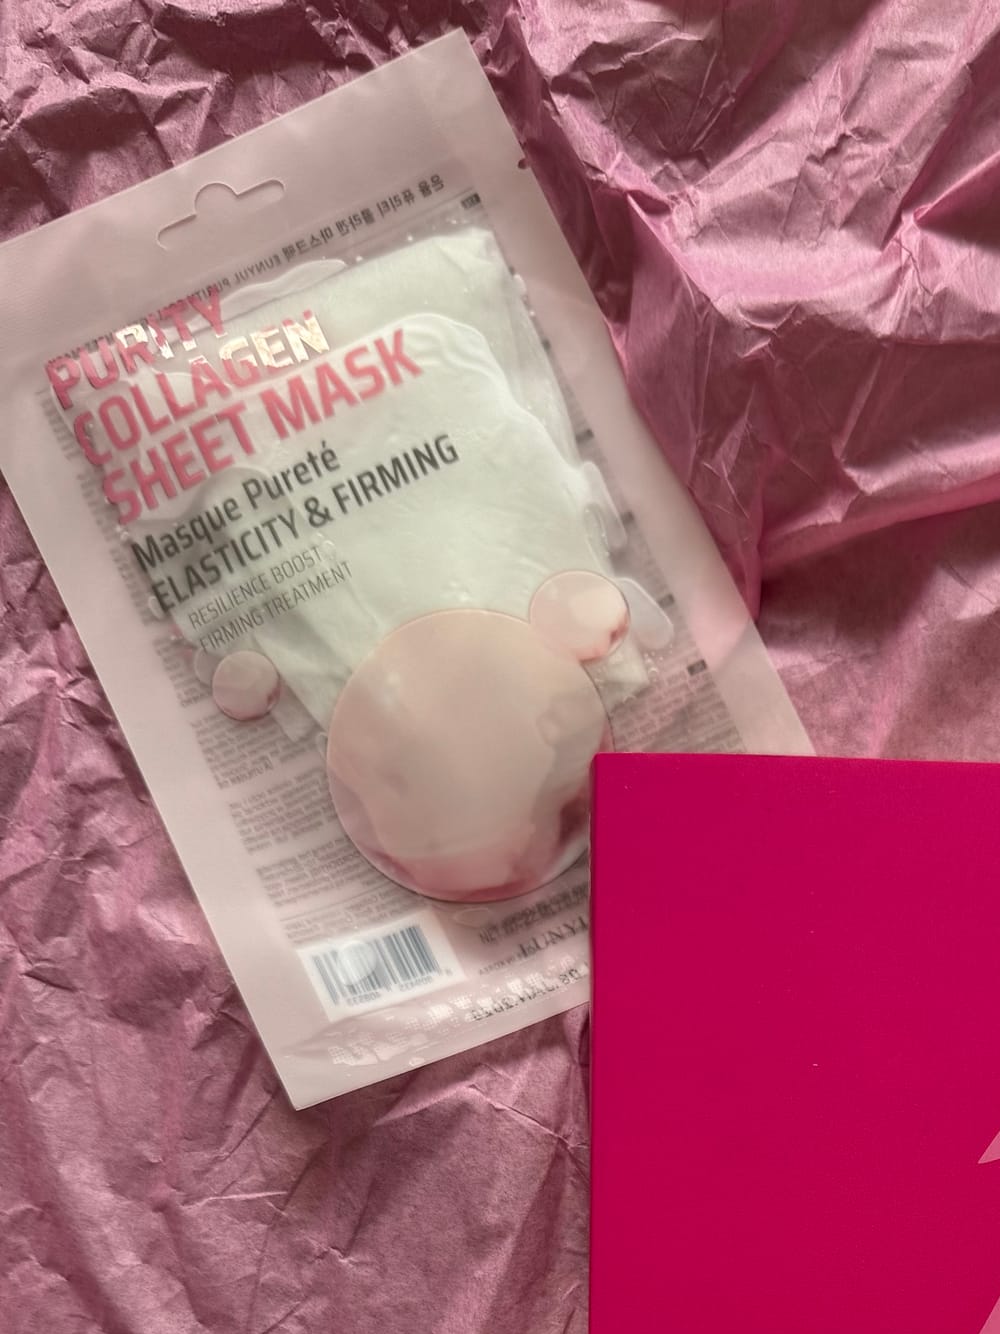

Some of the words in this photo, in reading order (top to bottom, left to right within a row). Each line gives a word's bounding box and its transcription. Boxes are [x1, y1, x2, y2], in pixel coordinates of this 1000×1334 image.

[45, 286, 228, 410] PURITY
[73, 310, 330, 465] COLLAGEN
[103, 401, 256, 525] SHEET
[259, 329, 423, 439] MASK
[132, 494, 242, 572] Masque
[241, 441, 340, 509] Pureté
[153, 510, 301, 614] ELASTICITY
[305, 496, 335, 528] &
[332, 434, 461, 515] FIRMING
[188, 575, 268, 630] RESILIENCE
[271, 545, 323, 583] BOOST
[199, 612, 265, 653] FIRMING
[265, 562, 354, 618] TREATMENT
